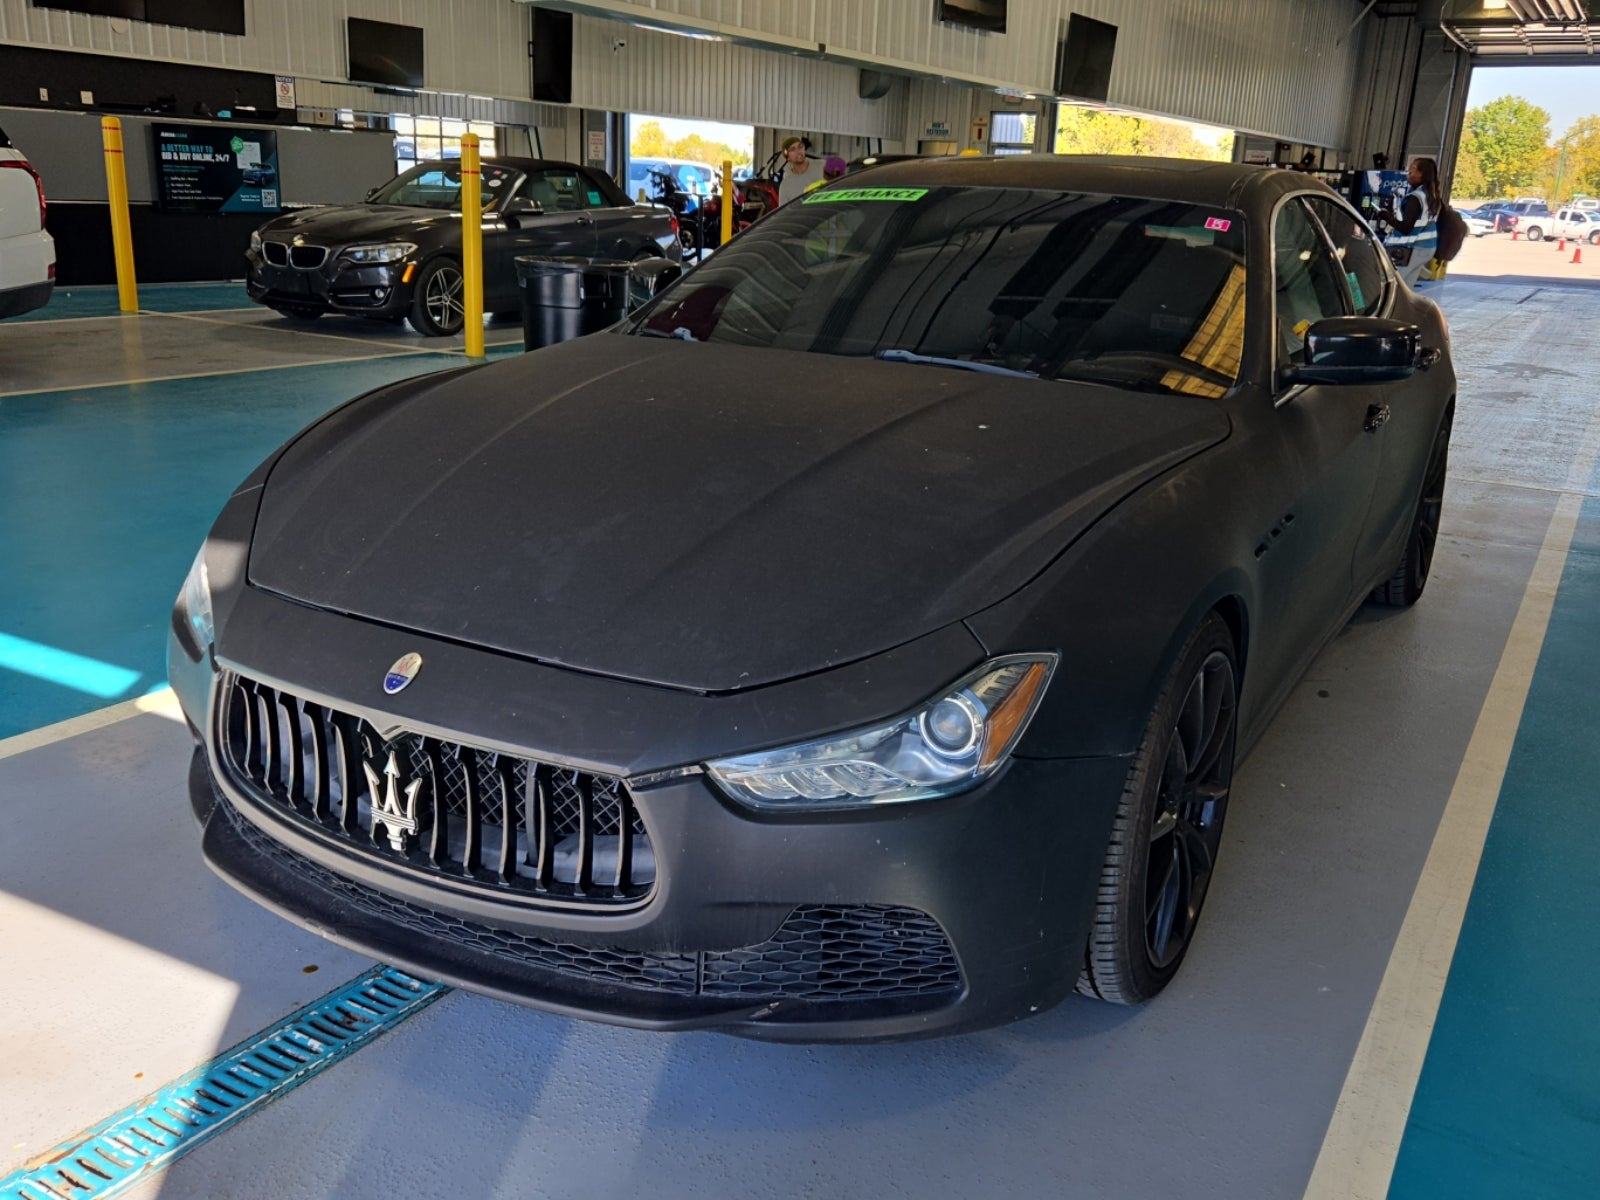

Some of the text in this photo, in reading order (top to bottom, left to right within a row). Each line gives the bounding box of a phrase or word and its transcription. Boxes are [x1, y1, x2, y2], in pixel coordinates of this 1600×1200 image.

[161, 143, 166, 151] A
[167, 144, 190, 152] BETTER
[190, 145, 203, 153] WAY
[162, 151, 172, 160] BID
[173, 152, 179, 160] &
[179, 152, 191, 161] BUY
[215, 154, 230, 162] 24/7
[807, 190, 923, 202] WE FINANCE
